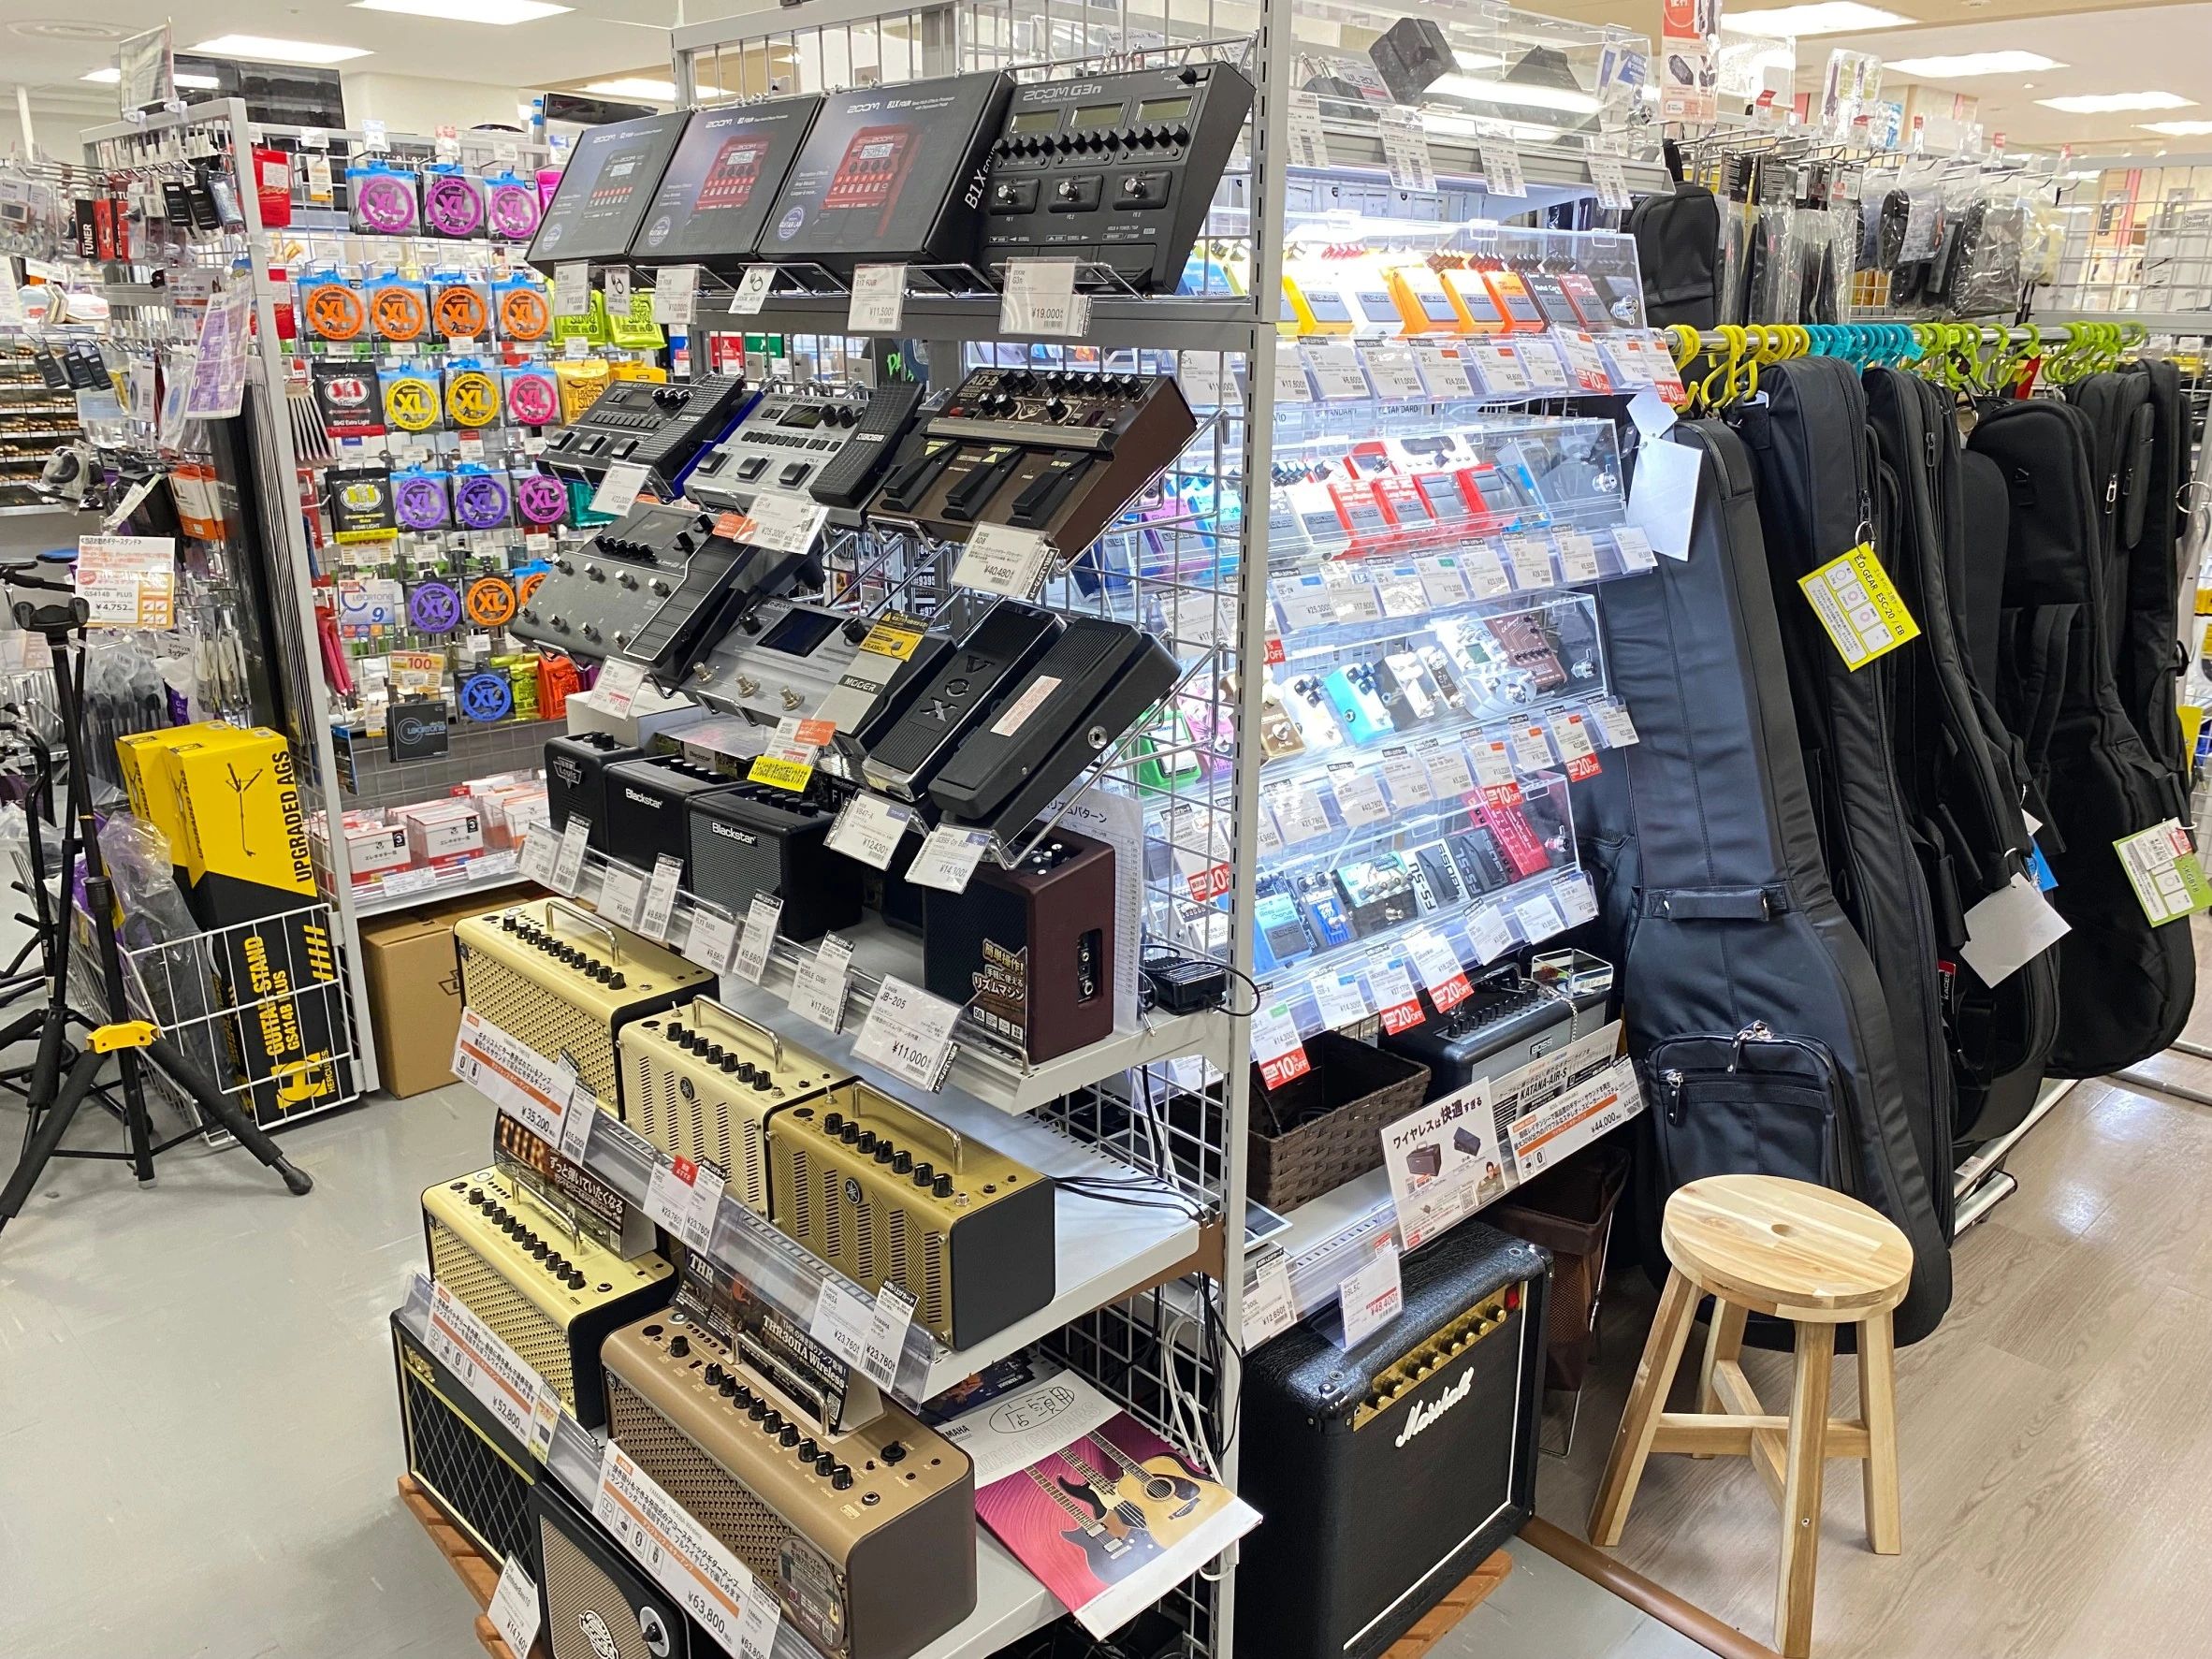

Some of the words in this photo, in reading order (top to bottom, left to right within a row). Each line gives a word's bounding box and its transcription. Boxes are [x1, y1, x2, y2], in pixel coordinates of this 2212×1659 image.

[1023, 85, 1070, 101] ZOOM
[1070, 84, 1102, 95] G3n
[847, 102, 880, 114] ZOOM
[706, 119, 733, 128] ZOOM
[965, 169, 987, 209] B1X
[370, 191, 405, 216] XL
[439, 194, 471, 217] XL
[499, 200, 529, 223] XL
[84, 224, 95, 255] TUNER
[313, 297, 352, 323] XL
[382, 302, 416, 322] XL
[444, 301, 481, 322] XL
[513, 302, 541, 322] XL
[397, 393, 429, 415] XL
[458, 388, 491, 411] XL
[519, 389, 548, 410] XL
[407, 493, 437, 512] XL
[468, 493, 499, 512] XL
[526, 489, 561, 510] XL
[421, 598, 452, 618] XL
[477, 591, 507, 613] XL
[1876, 592, 1896, 619] ESC-20
[1895, 624, 1905, 636] EB
[407, 658, 432, 670] 100
[1269, 648, 1283, 660] OFF
[844, 677, 877, 692] MOOER
[921, 658, 997, 723] VOX
[469, 694, 502, 715] XL
[272, 750, 295, 785] AGS
[625, 788, 663, 809] Blackstar
[280, 791, 313, 882] UPGRADED
[711, 822, 757, 844] Blackstar
[244, 936, 272, 994] STAND
[984, 942, 1025, 976] 簡単操作!
[974, 975, 1025, 1002] リズムマシン
[986, 968, 1024, 987] 手軽に使える
[880, 994, 907, 1010] JB-205
[1458, 985, 1471, 997] OFF
[280, 1003, 300, 1051] GS414B
[1411, 1011, 1423, 1021] OFF
[322, 1049, 336, 1093] HERCUES
[1294, 1060, 1308, 1071] OFF
[1393, 1097, 1482, 1150] ワイヤレスは快適すぎる
[549, 1156, 623, 1215] ずっと弾いていたくなる
[690, 1252, 714, 1284] THR
[884, 1280, 915, 1304] お買い上げカード
[1344, 1282, 1361, 1297] DSL5C
[808, 1349, 845, 1389] Wireless
[1395, 1366, 1475, 1448] Marshall
[943, 1425, 970, 1439] MAHA
[1028, 1403, 1101, 1450] GUITARS
[688, 1591, 726, 1633] ¥63,800
